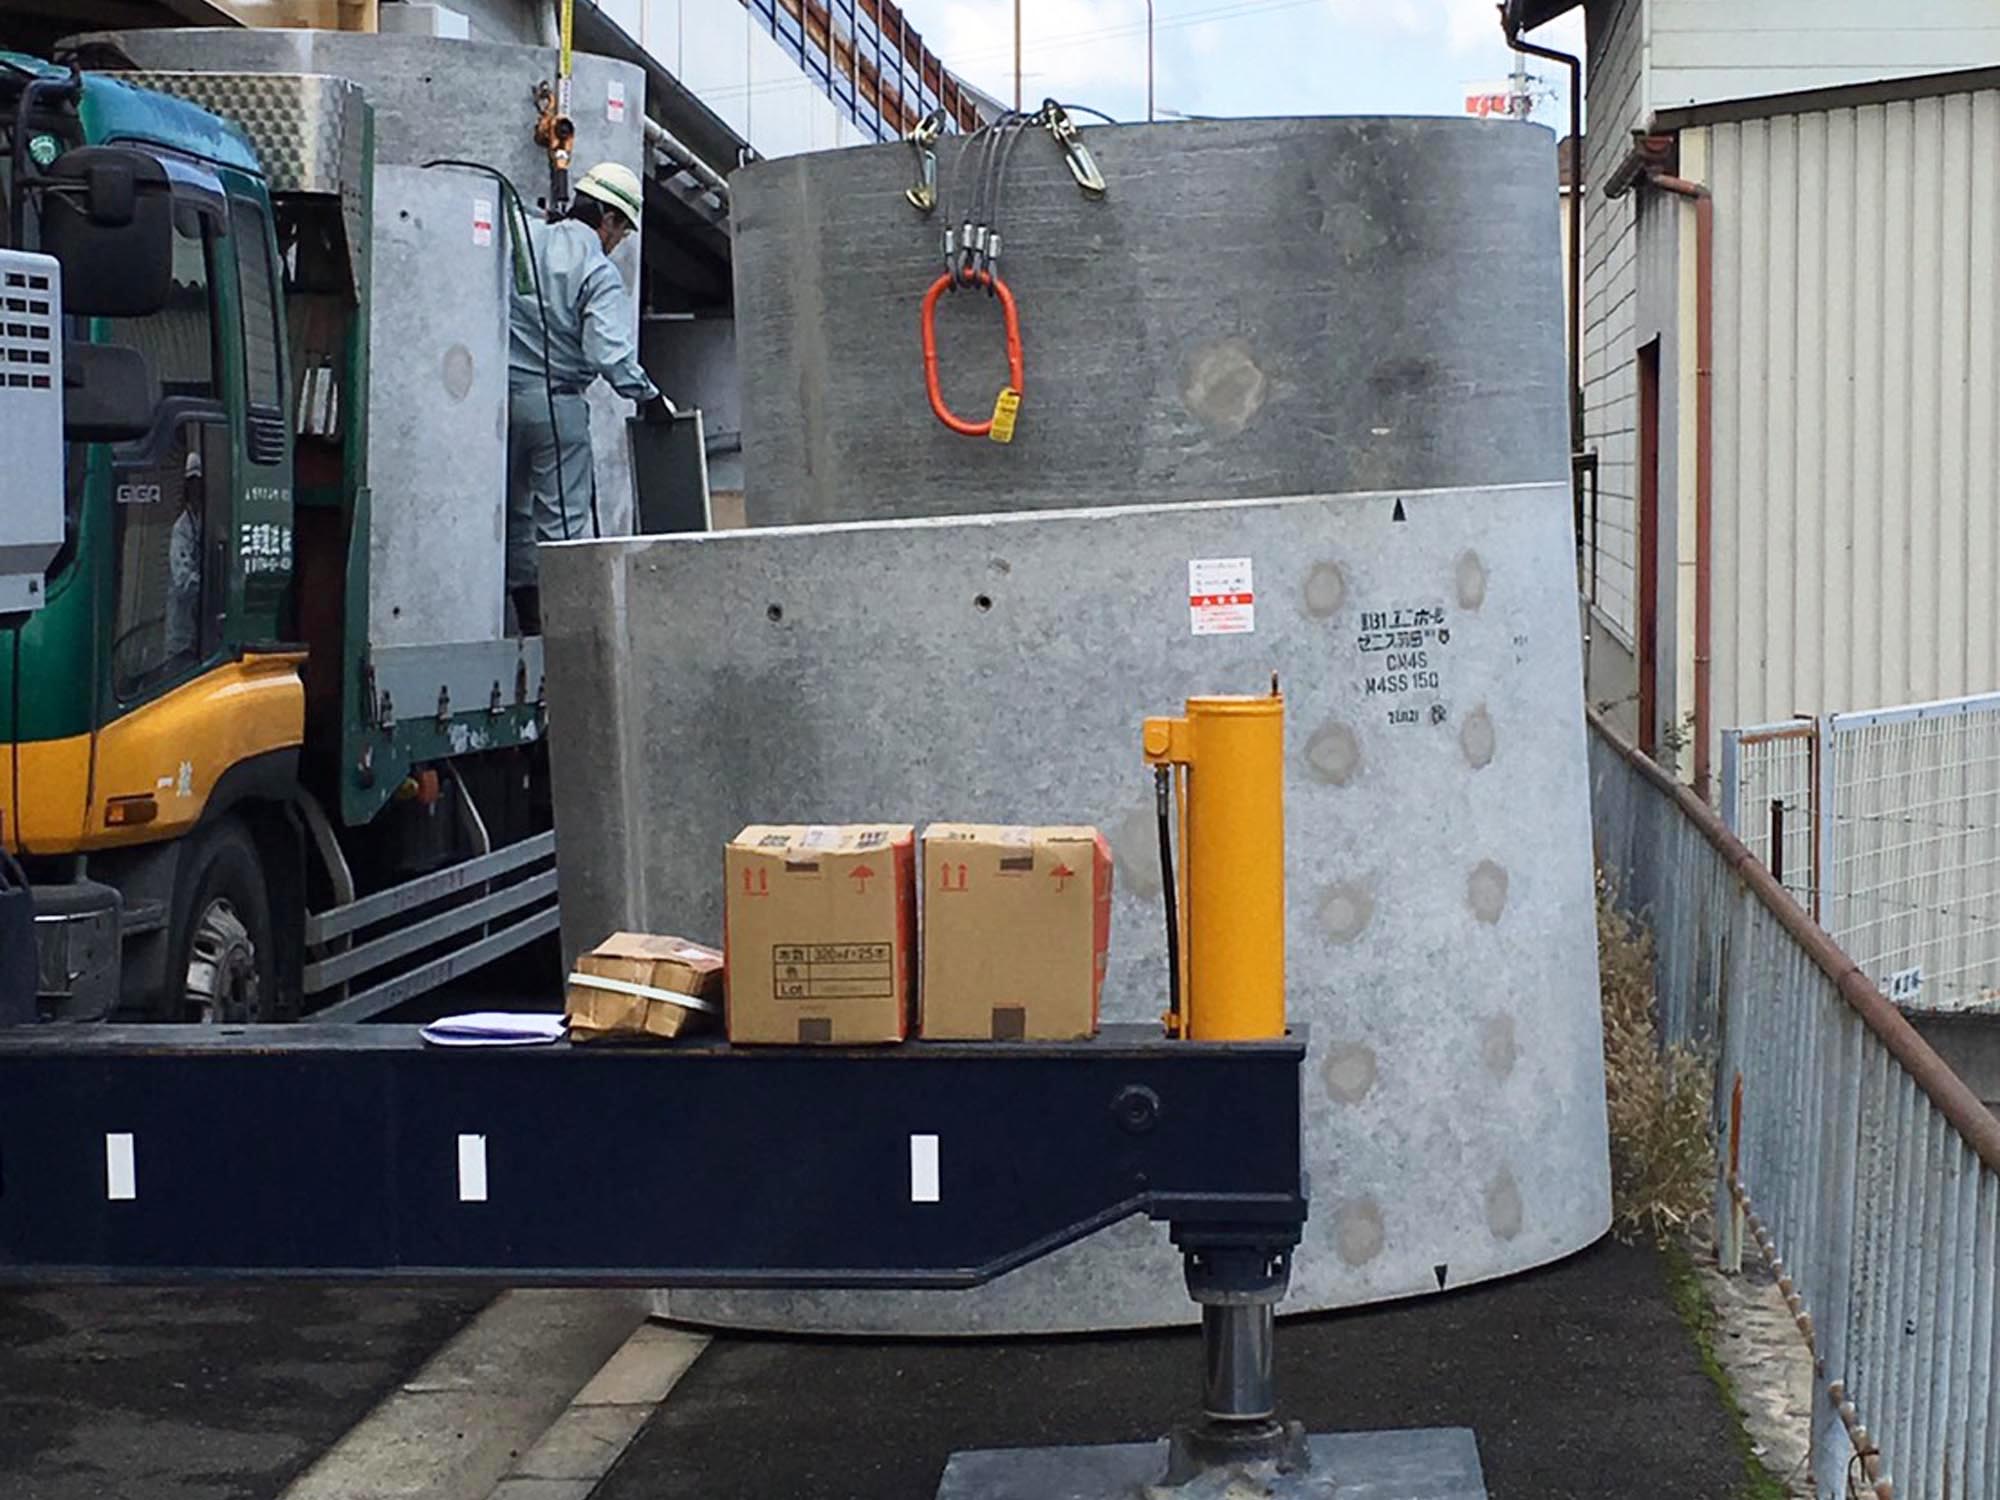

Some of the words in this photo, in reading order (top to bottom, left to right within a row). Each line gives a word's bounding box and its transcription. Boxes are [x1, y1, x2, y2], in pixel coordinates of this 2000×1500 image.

[117, 485, 161, 503] GIGA
[1412, 671, 1440, 689] 150
[780, 984, 803, 996] Lot
